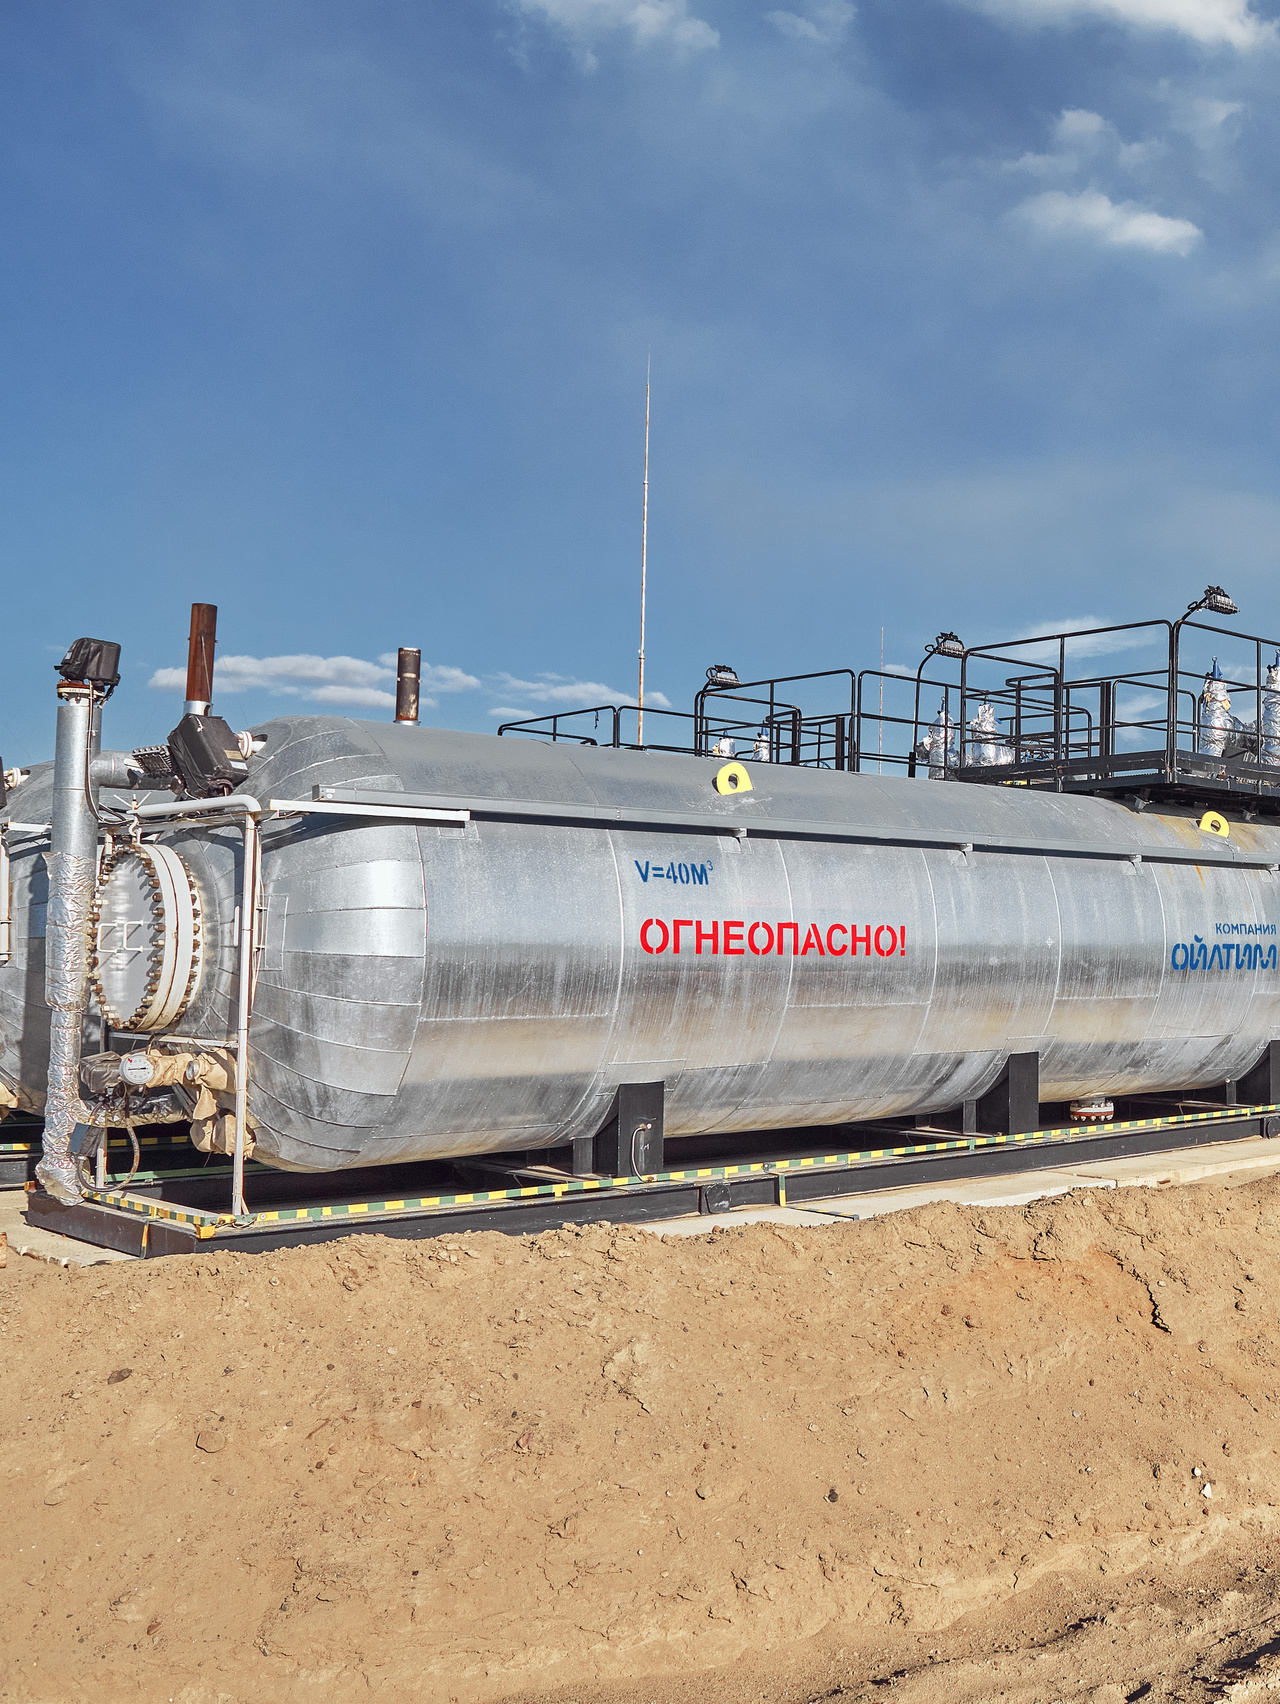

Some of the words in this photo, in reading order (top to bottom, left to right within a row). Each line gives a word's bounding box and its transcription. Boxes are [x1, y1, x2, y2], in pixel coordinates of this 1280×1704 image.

[639, 918, 906, 958] ОГНЕОПАСНО!
[1215, 922, 1277, 936] КОМПАНИЯ
[1170, 933, 1278, 972] ОЙЛТИМ
